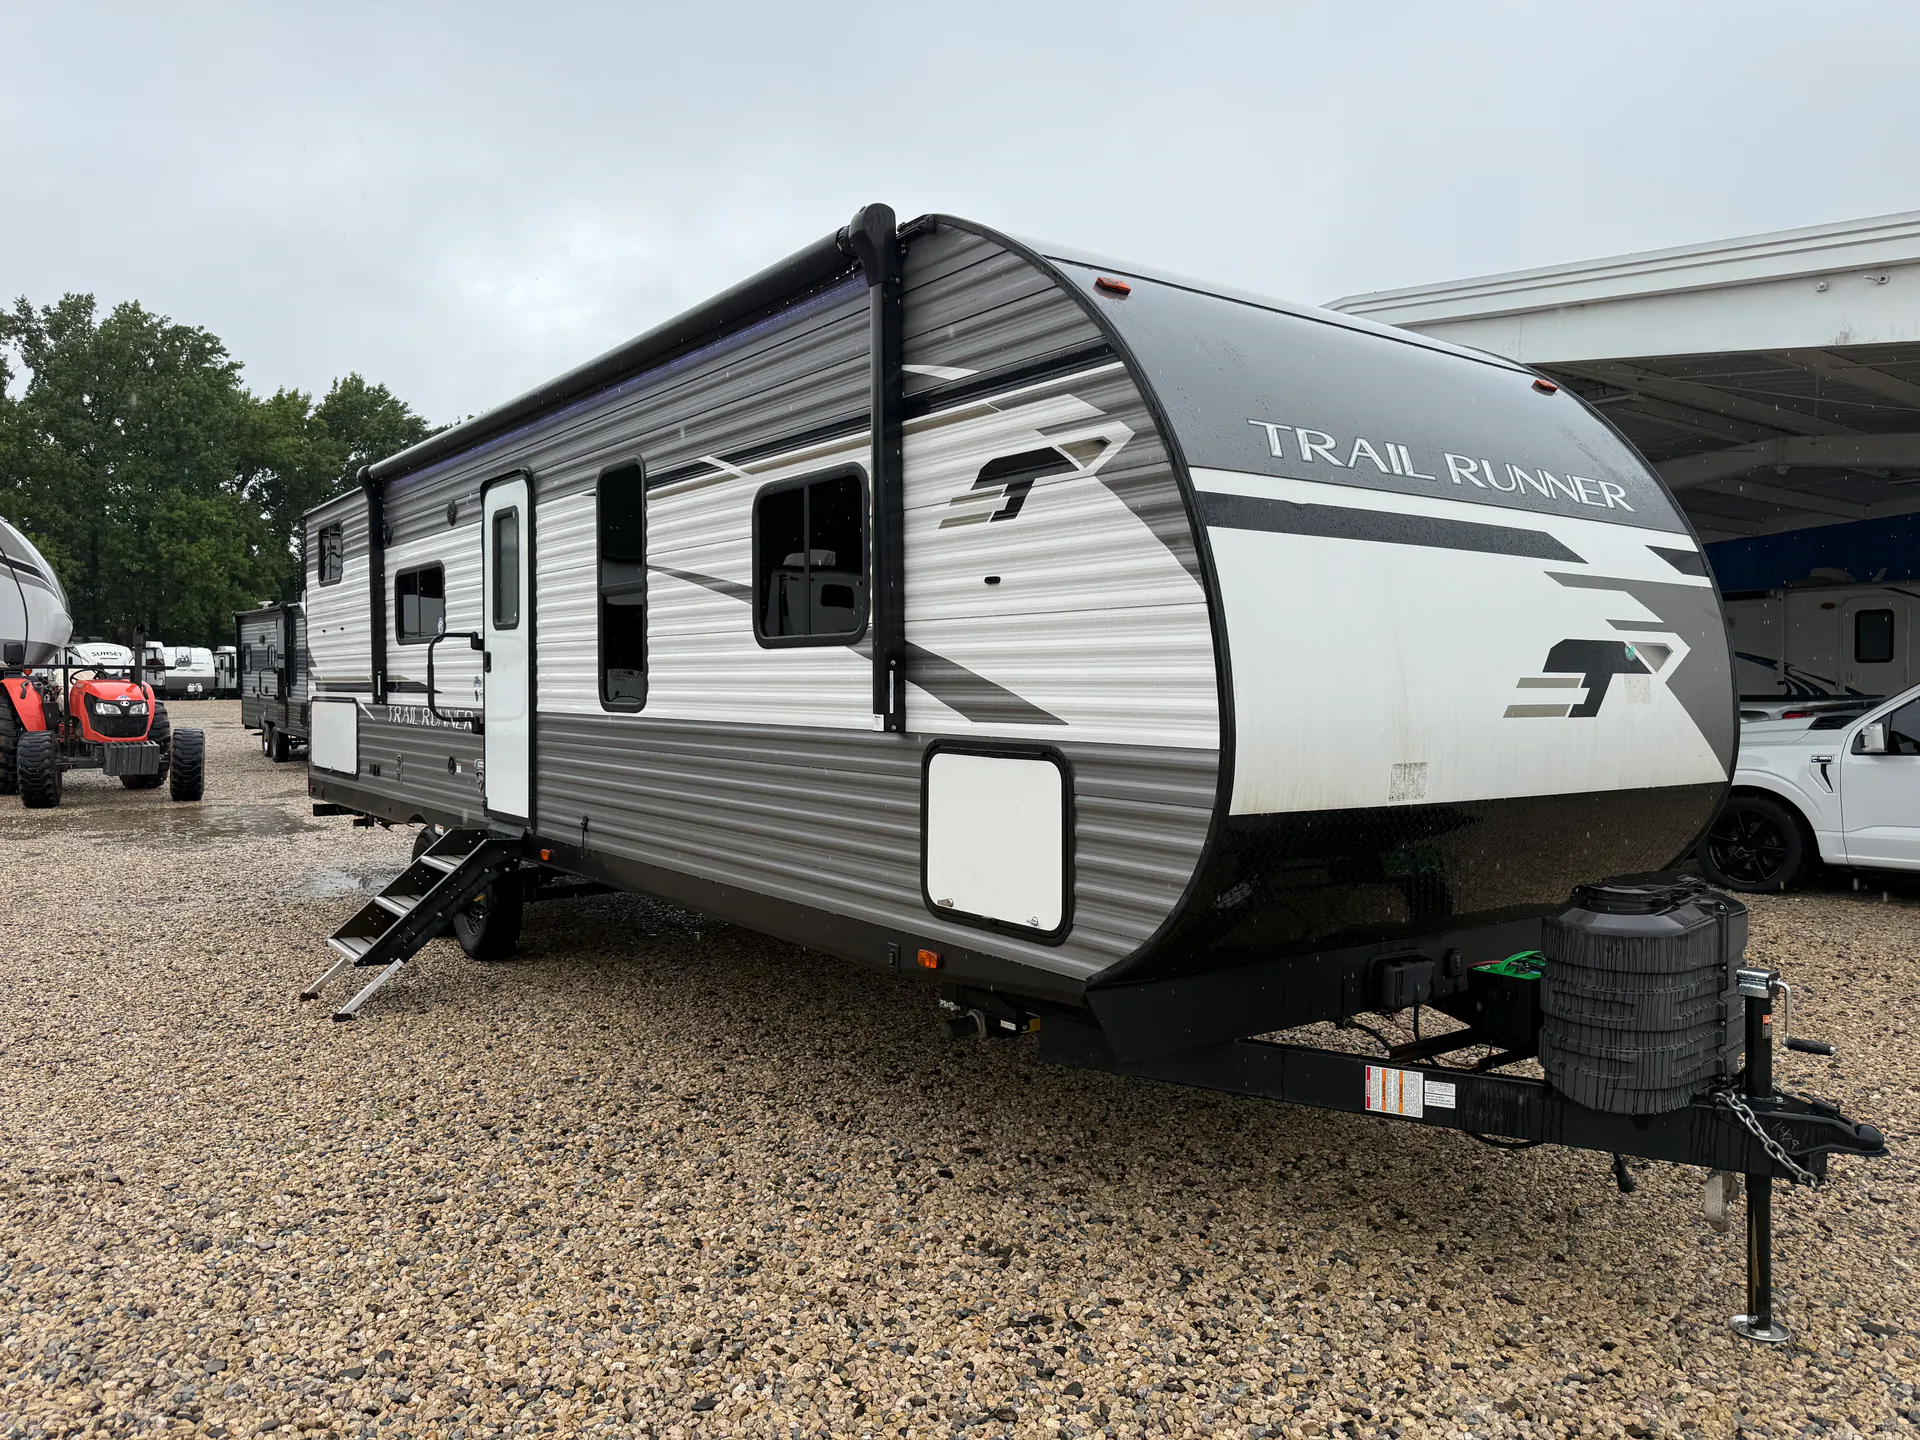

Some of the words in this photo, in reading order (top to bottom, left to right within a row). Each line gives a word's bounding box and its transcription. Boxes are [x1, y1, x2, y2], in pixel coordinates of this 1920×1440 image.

[1247, 418, 1436, 482] TRAIL
[1443, 451, 1636, 513] RUNNER
[388, 705, 418, 725] TRAIL
